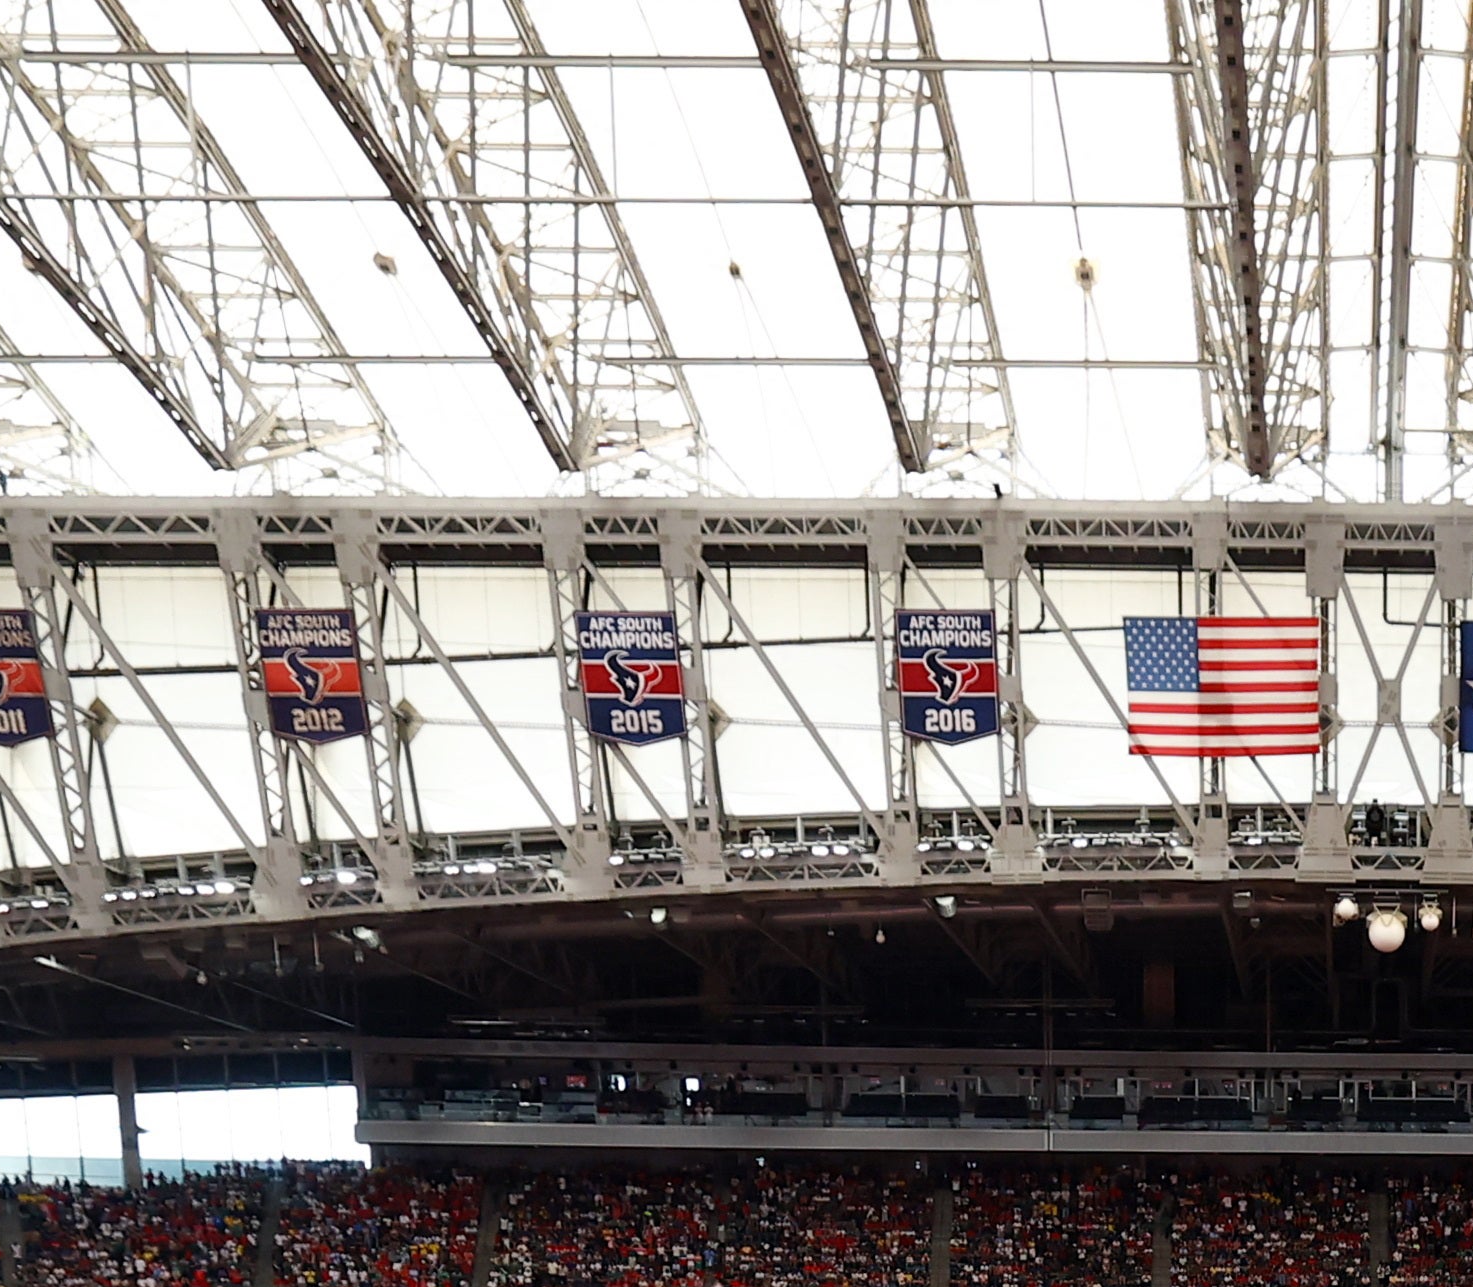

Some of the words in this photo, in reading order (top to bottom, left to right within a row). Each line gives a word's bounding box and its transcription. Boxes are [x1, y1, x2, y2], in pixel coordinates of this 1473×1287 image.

[268, 614, 293, 629] AFC
[296, 614, 341, 629] SOUTH
[589, 617, 615, 631] AFC
[618, 617, 663, 631] SOUTH
[910, 616, 934, 630] AFC
[937, 616, 981, 630] SOUTH
[260, 628, 352, 647] CHAMPIONS
[579, 631, 674, 650] CHAMPIONS
[900, 630, 992, 648] CHAMPIONS
[291, 708, 346, 733] 2012
[610, 709, 662, 734] 2015
[925, 708, 976, 734] 2016
